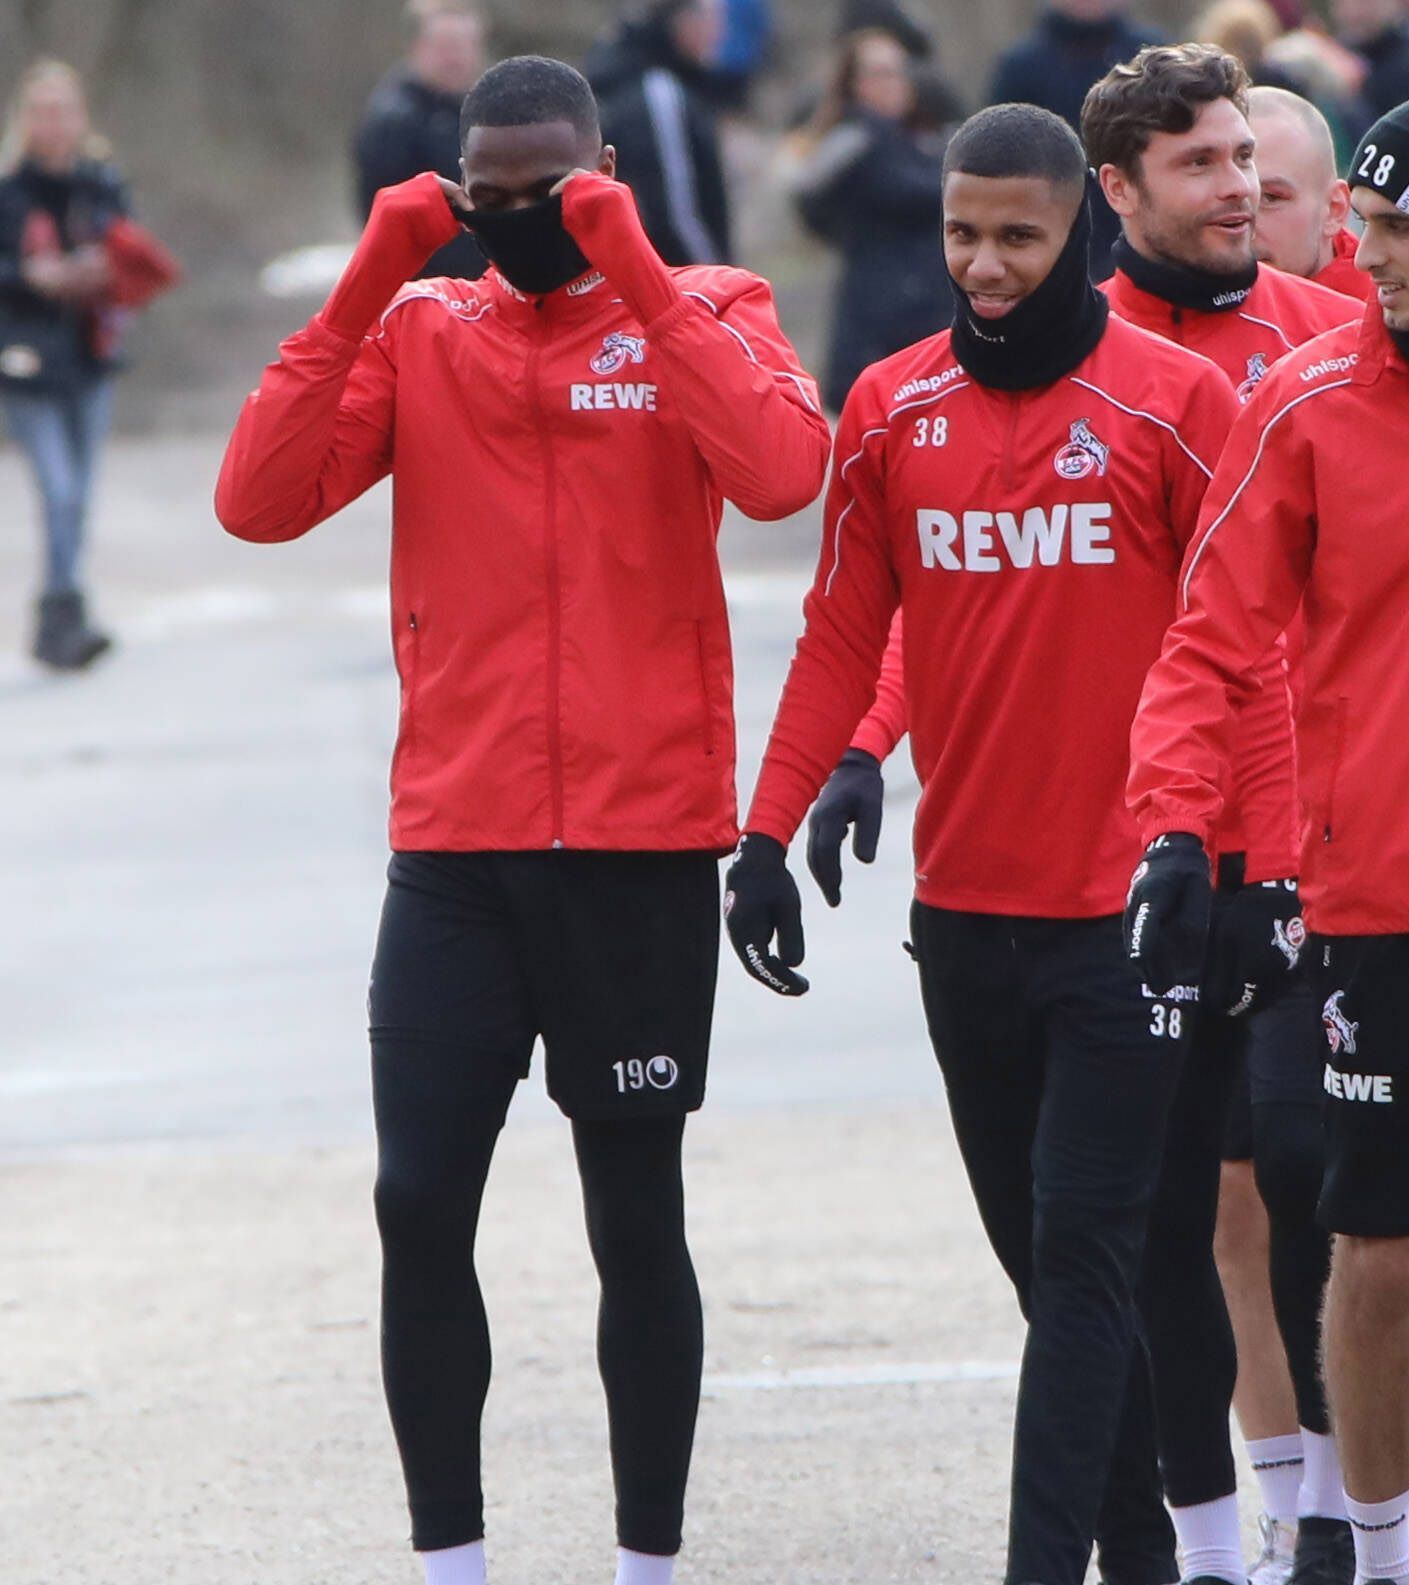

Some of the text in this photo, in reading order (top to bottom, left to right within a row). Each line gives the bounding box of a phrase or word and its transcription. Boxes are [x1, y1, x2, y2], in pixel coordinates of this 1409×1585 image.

[1357, 144, 1395, 187] 28
[570, 382, 657, 412] REWE
[912, 416, 949, 448] 38
[916, 502, 1116, 573] REWE
[1149, 1003, 1182, 1039] 38
[612, 1058, 644, 1093] 19
